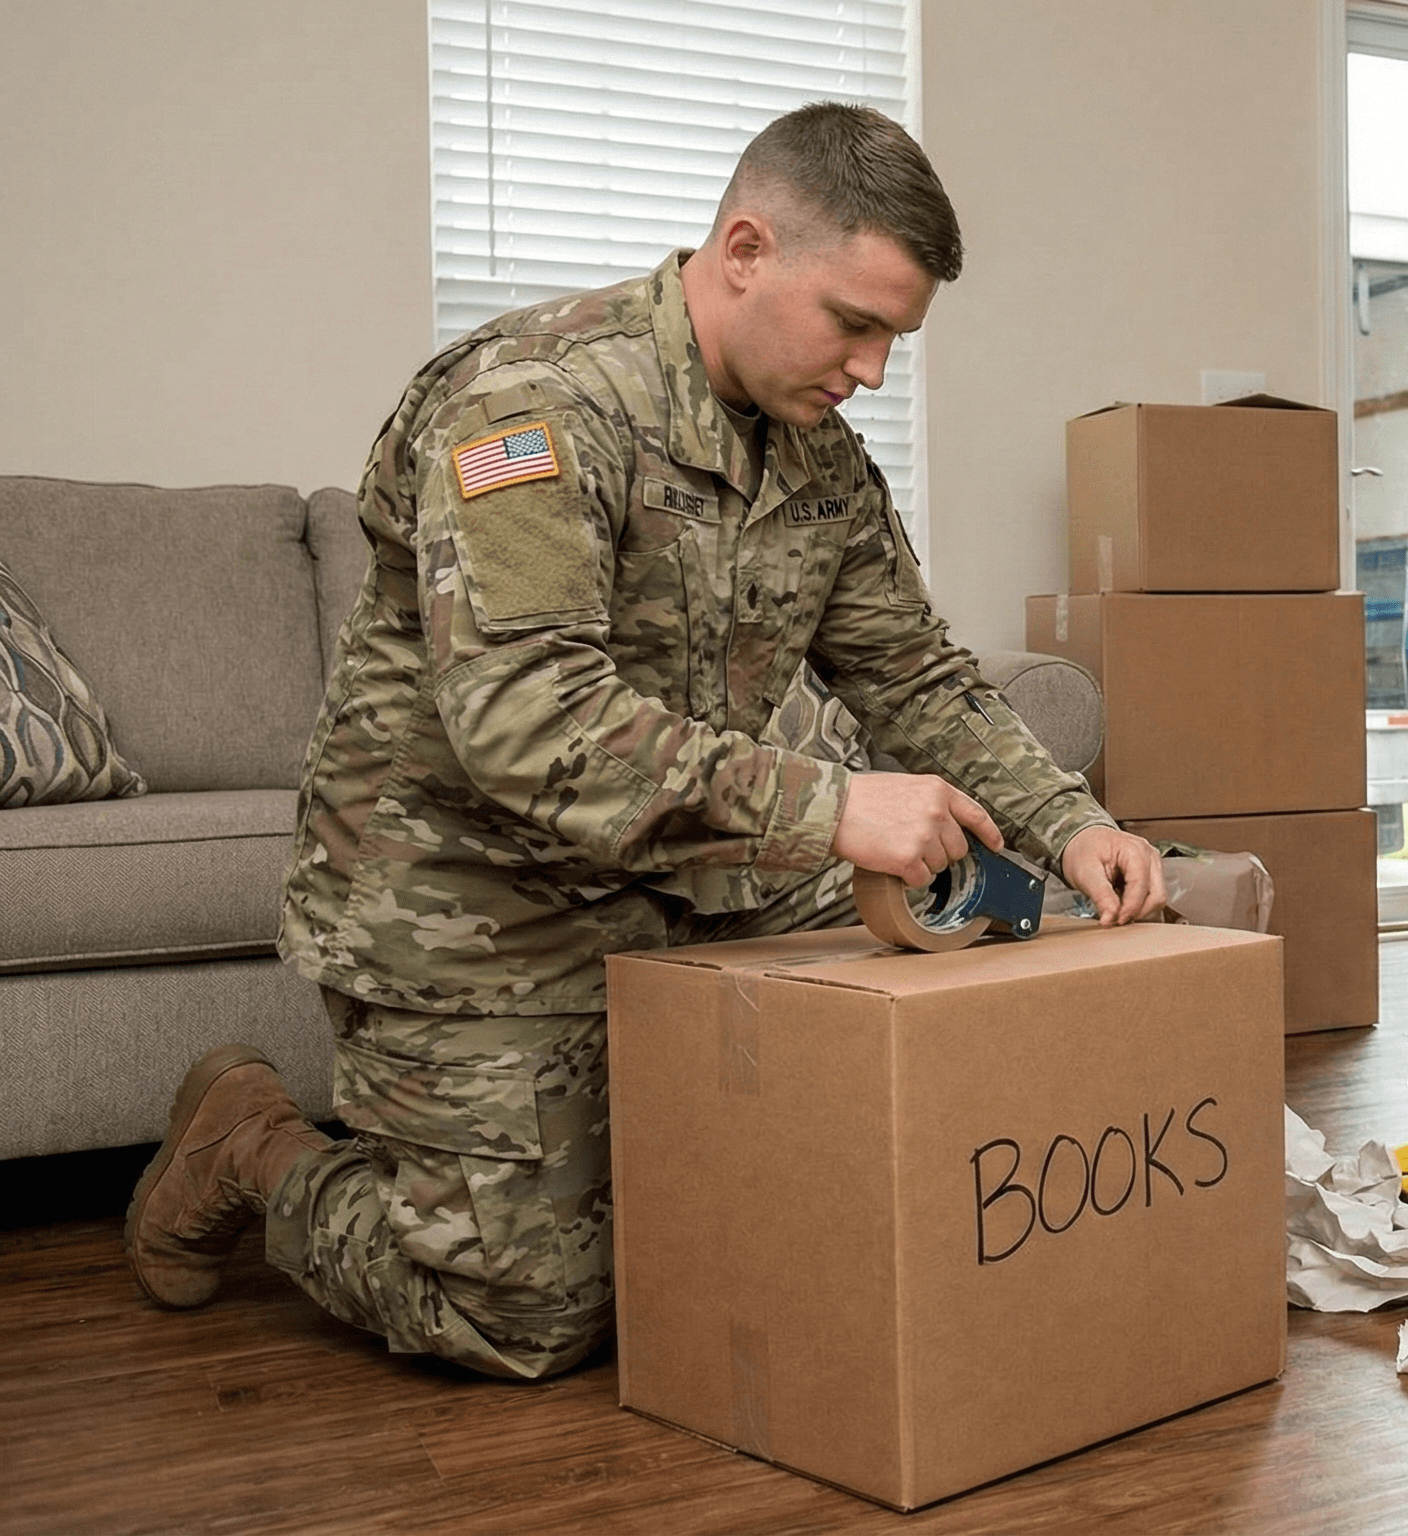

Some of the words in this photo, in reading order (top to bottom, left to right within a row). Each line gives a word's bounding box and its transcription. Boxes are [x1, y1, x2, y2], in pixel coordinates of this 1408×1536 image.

[790, 502, 816, 522] U.S.
[818, 497, 849, 520] ARMY
[969, 1096, 1228, 1265] BOOKS
